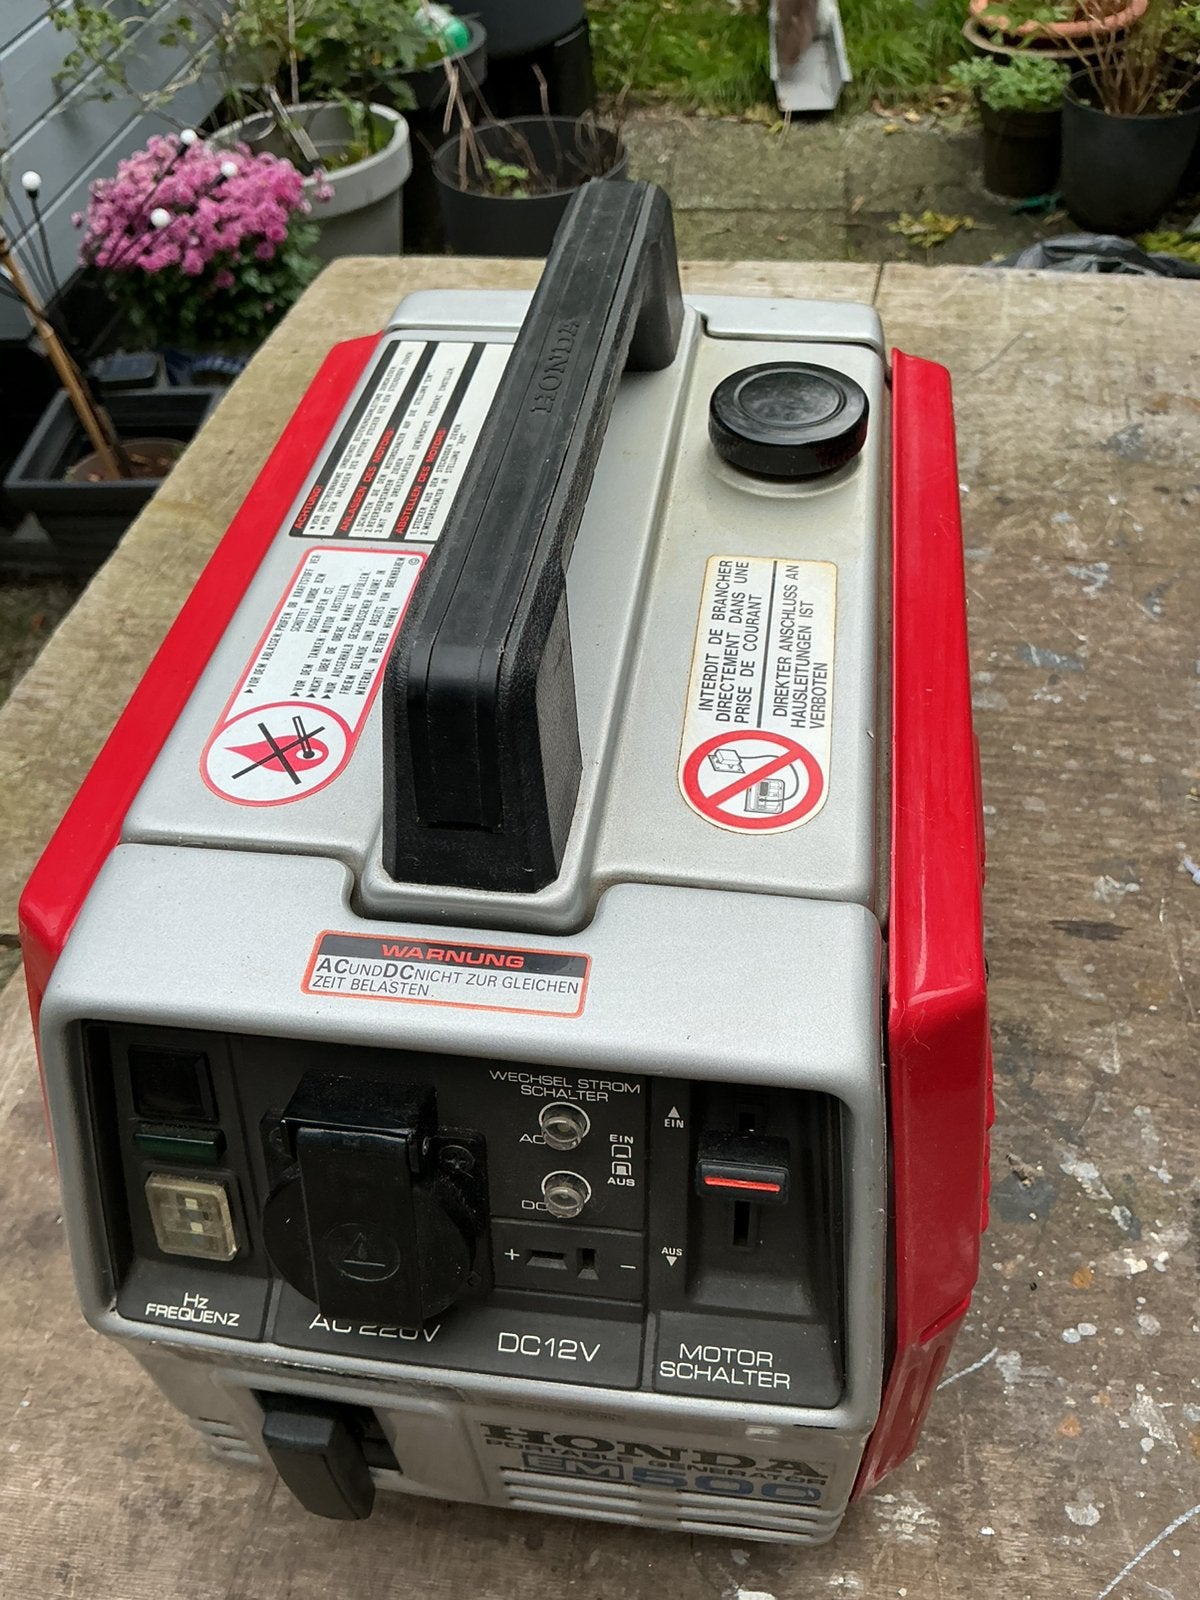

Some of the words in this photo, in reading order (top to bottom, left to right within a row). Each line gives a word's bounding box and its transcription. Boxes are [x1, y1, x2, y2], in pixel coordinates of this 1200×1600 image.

[530, 322, 580, 413] HONDA
[339, 486, 368, 530] ANLASSEN
[362, 466, 377, 482] DES
[394, 486, 423, 533] ABSTELLEN
[416, 466, 430, 481] DES
[734, 561, 749, 584] UNE
[785, 564, 799, 581] AN
[711, 560, 733, 621] BRANCHER
[728, 591, 745, 624] DANS
[779, 584, 798, 652] ANSCHLUSS
[798, 600, 814, 620] IST
[743, 594, 762, 652] COURANT
[708, 628, 723, 645] DE
[292, 680, 306, 690] VOR
[299, 664, 313, 675] DEM
[715, 632, 741, 722] DIRECTEMENT
[740, 660, 755, 677] DE
[790, 625, 812, 729] HAUSLEITUNGEN
[323, 682, 337, 693] NUR
[698, 653, 720, 711] INTERDIT
[773, 656, 792, 717] DIREKTER
[734, 686, 752, 724] PRISE
[809, 662, 828, 729] VERBOTEN
[381, 944, 525, 968] WARNUNG
[312, 975, 345, 990] ZEIT
[465, 972, 498, 988] ZUR
[502, 976, 580, 995] GLEICHEN
[489, 1070, 573, 1088] WECHSEL
[578, 1078, 641, 1094] STROM
[520, 1085, 609, 1102] SCHALTER
[664, 1118, 684, 1129] EIN
[609, 1134, 634, 1144] EIN
[607, 1177, 636, 1187] AUS
[661, 1246, 683, 1256] AUS
[184, 1292, 209, 1309] Hz
[145, 1303, 241, 1327] FREQUENZ
[679, 1343, 773, 1367] MOTOR
[659, 1361, 791, 1390] SCHALTER
[480, 1423, 829, 1478] HONDA
[648, 1460, 827, 1486] GENERATOR
